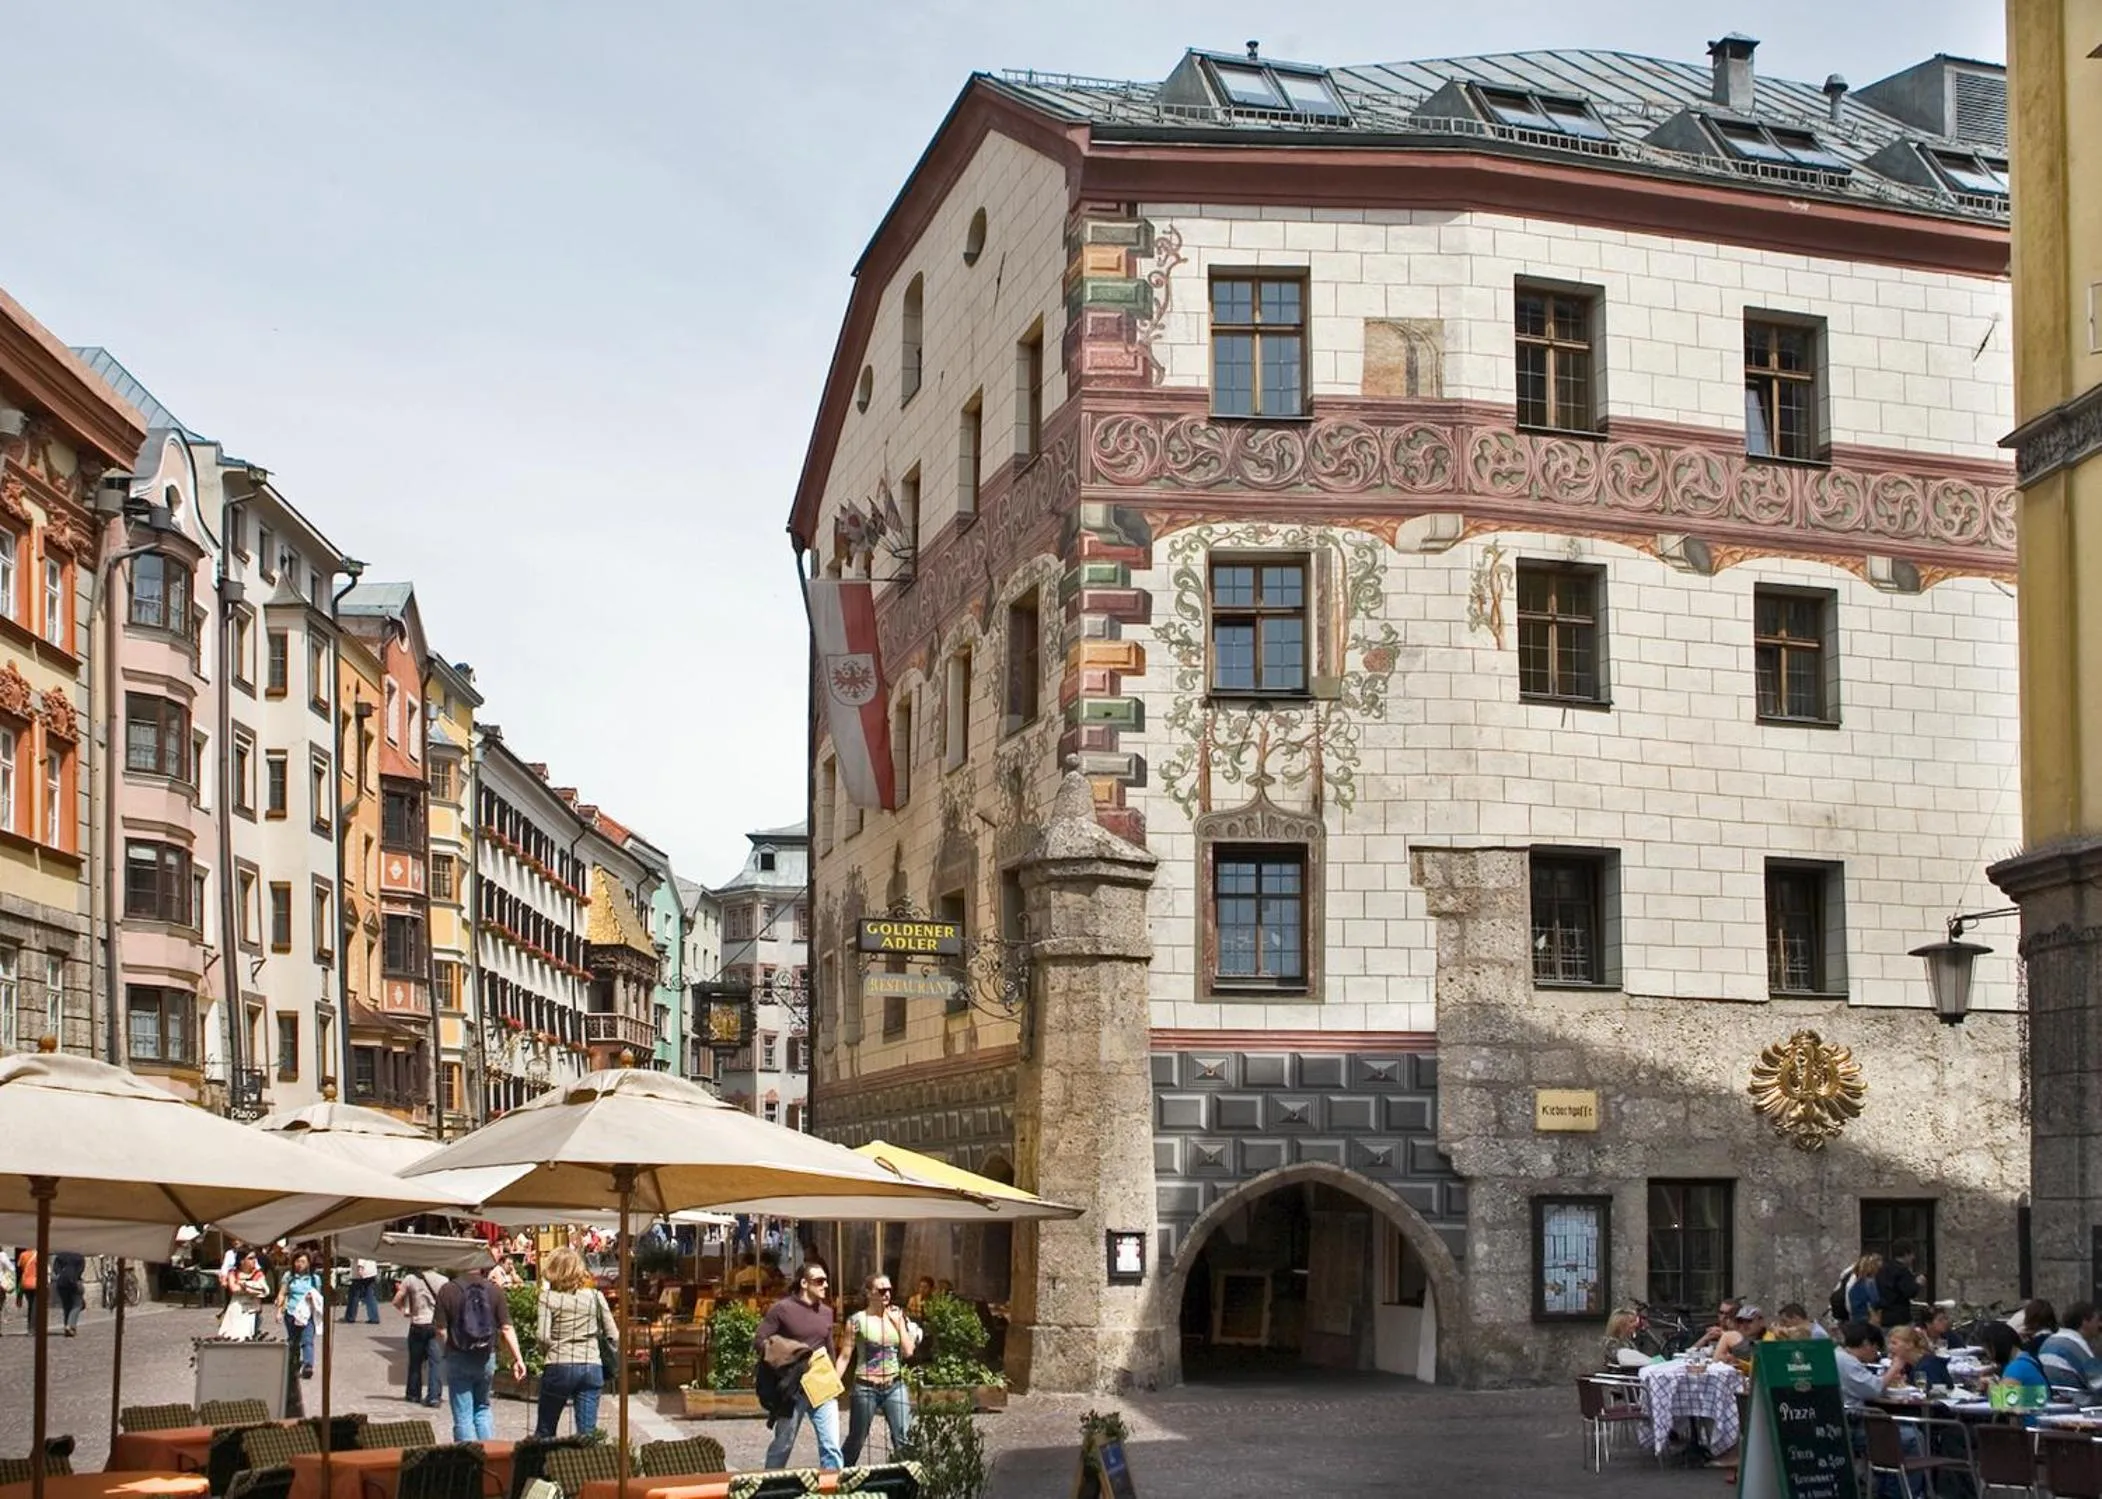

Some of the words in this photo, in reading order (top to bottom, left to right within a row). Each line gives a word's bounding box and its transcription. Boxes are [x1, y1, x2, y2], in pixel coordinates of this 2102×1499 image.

[866, 922, 955, 938] GOLDENER
[881, 937, 938, 950] ADLER
[867, 977, 956, 996] RESTAURANT
